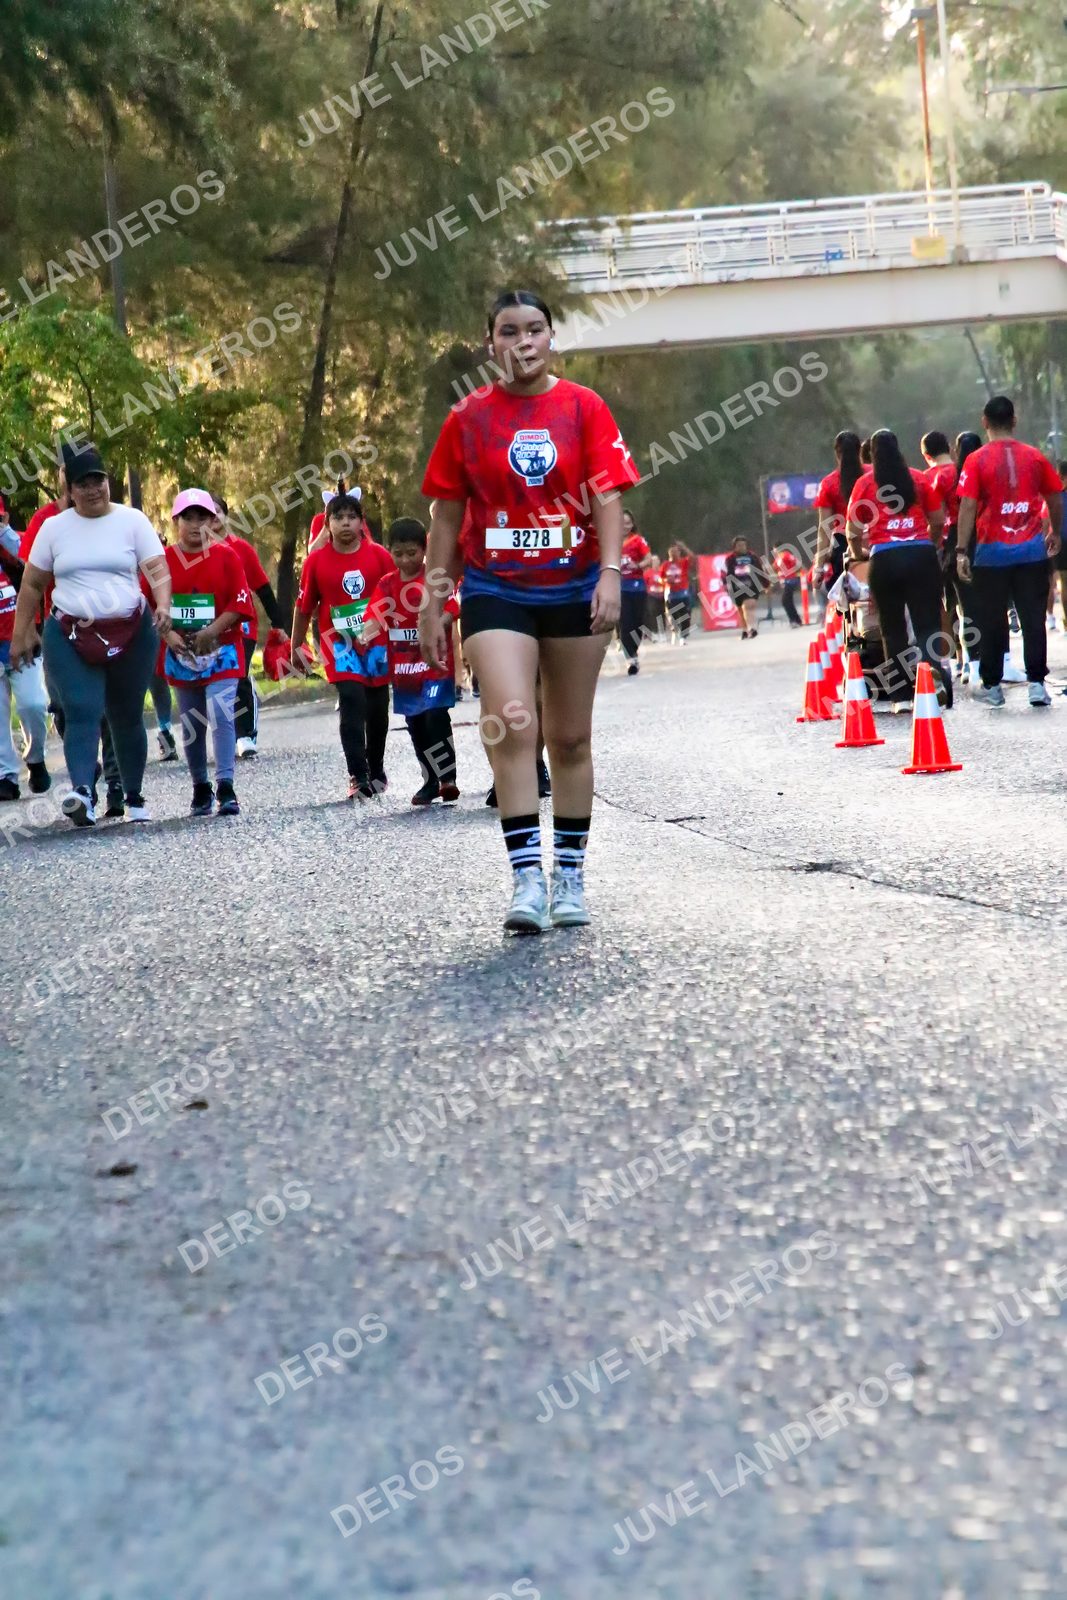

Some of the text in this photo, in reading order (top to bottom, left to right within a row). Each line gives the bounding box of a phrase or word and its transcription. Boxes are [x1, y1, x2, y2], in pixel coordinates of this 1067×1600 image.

[512, 530, 550, 547] 3278
[180, 608, 196, 618] 179
[345, 614, 363, 627] 890
